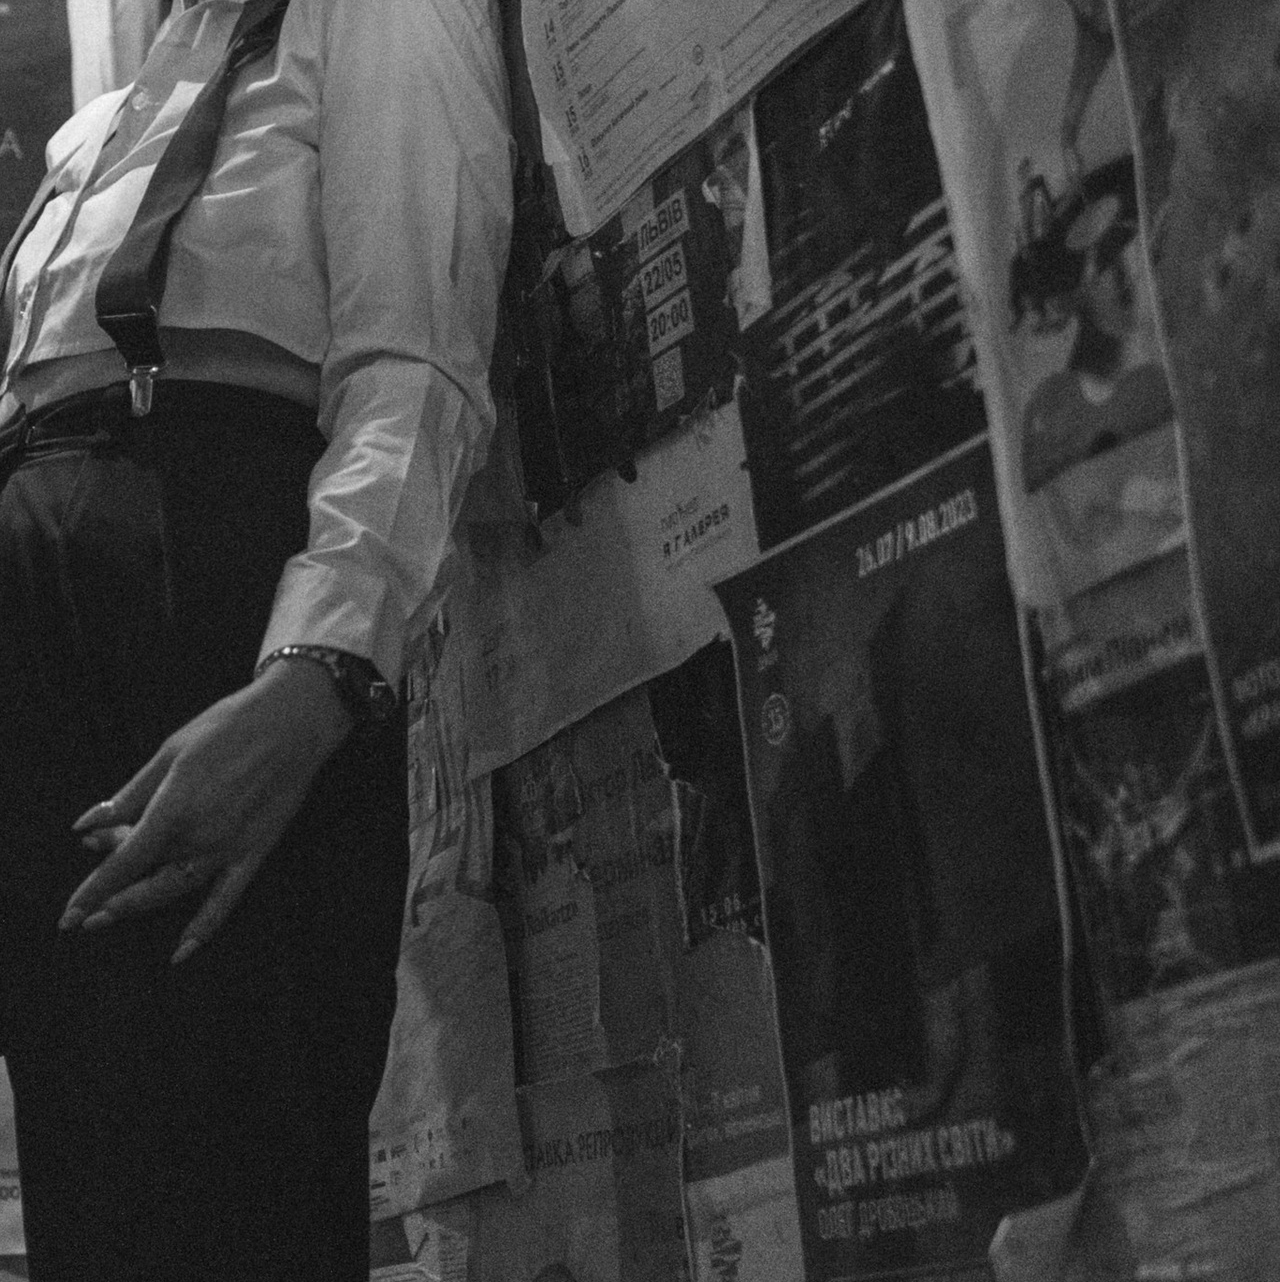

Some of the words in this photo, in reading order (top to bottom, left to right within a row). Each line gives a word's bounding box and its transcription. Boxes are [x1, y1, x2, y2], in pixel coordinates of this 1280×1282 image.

[640, 198, 684, 251] ЛЬВІВ
[643, 250, 683, 297] 22/05
[649, 296, 689, 343] 20:00
